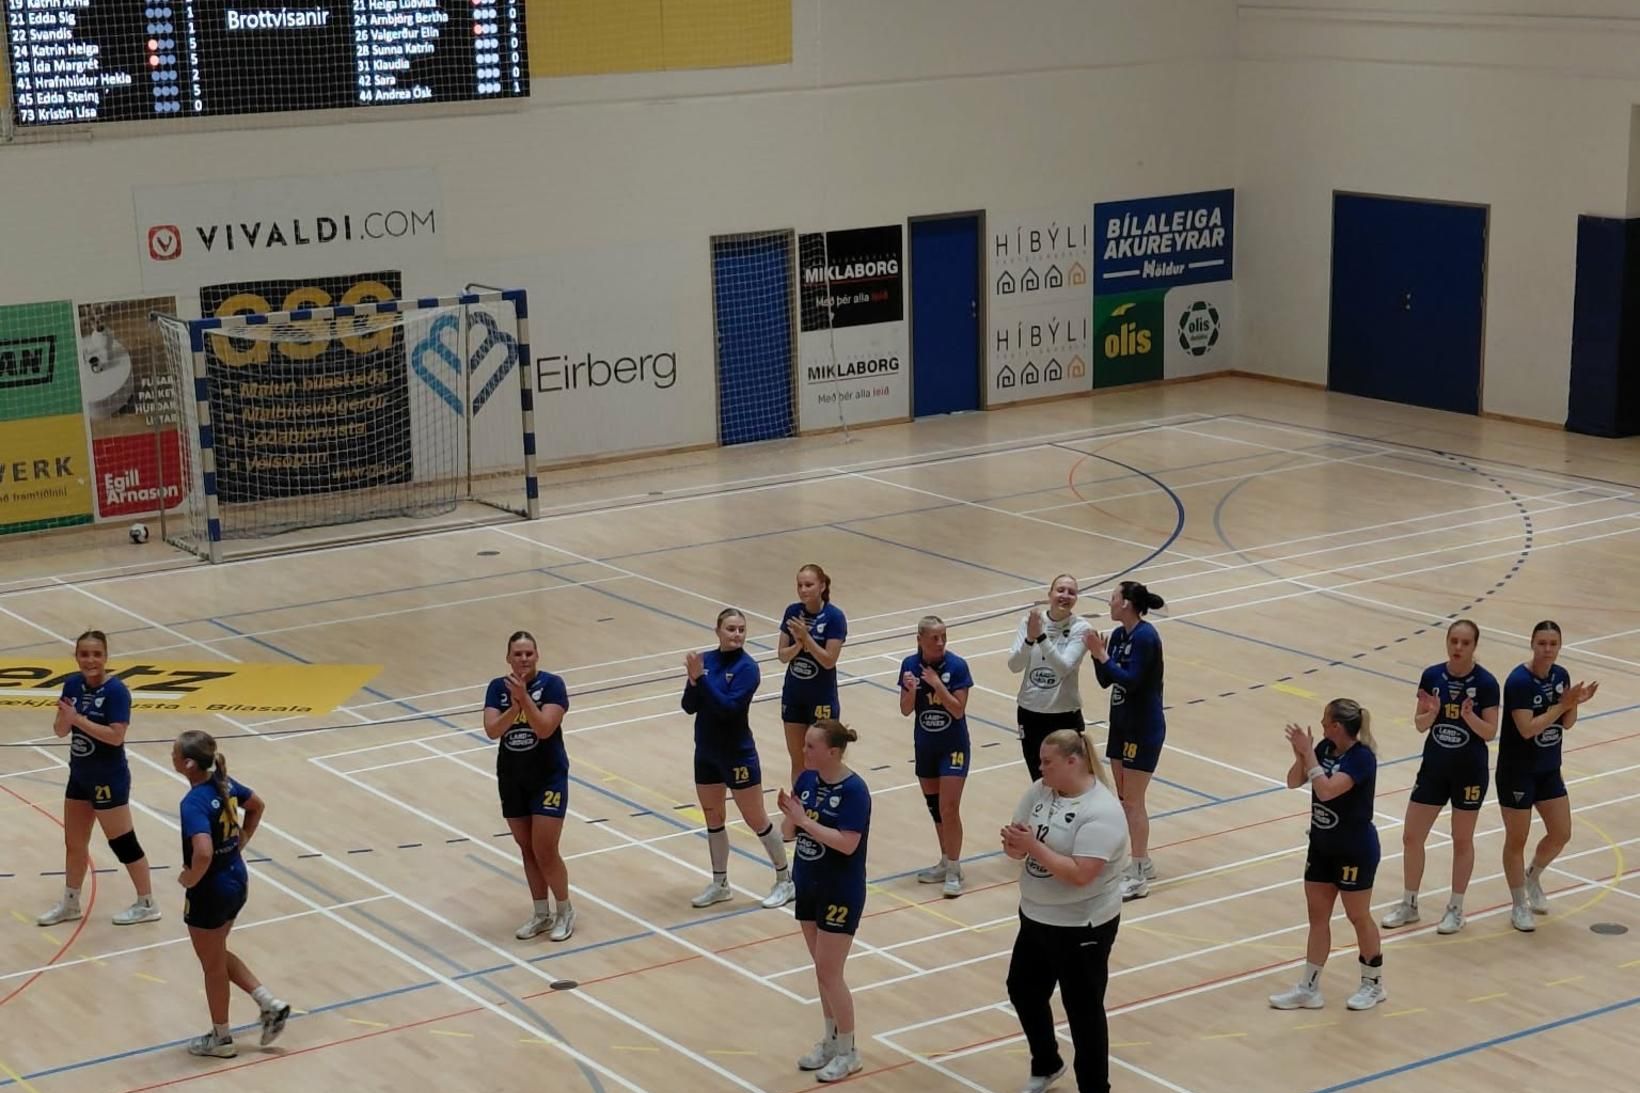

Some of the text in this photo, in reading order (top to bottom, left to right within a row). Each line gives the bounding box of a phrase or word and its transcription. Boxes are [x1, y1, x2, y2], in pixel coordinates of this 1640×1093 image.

[187, 6, 194, 18] 1
[353, 0, 366, 11] 21
[369, 0, 397, 12] Helga
[10, 11, 76, 25] 21 Edda Sig
[227, 6, 329, 29] Brottvísanir
[354, 14, 367, 26] 24
[415, 11, 449, 23] Bertha
[509, 8, 516, 19] 0
[188, 22, 195, 34] 1
[510, 22, 517, 33] 4
[12, 29, 27, 41] 22
[355, 29, 368, 41] 26
[189, 37, 197, 49] 5
[511, 37, 519, 48] 0
[14, 45, 28, 58] 24
[67, 42, 99, 56] Helga
[357, 45, 369, 56] 28
[372, 45, 403, 56] Sunna
[190, 54, 198, 65] 5
[358, 58, 410, 71] 31 Klaudia
[512, 52, 520, 63] 0
[16, 61, 30, 73] 28
[53, 58, 99, 73] Margrét
[513, 66, 520, 77] 0
[17, 72, 132, 89] 41 Hrafnhildur Hekla
[192, 69, 200, 81] 2
[358, 75, 396, 86] 42 Sara
[193, 84, 201, 96] 5
[514, 81, 521, 92] 1
[18, 93, 33, 105] 45
[37, 91, 64, 104] Edda
[359, 90, 372, 101] 44
[375, 88, 411, 100] Andrea
[194, 99, 203, 111] 0
[21, 105, 97, 122] 73 Kristín Lísa
[196, 209, 436, 251] VIVALDI.COM
[1106, 207, 1222, 239] BÍLALEIGA
[996, 222, 1087, 257] HÍBÝLI
[1103, 227, 1225, 261] AKUREYRAR
[805, 259, 899, 283] MIKLABORG
[854, 292, 870, 303] alla
[996, 317, 1087, 352] HÍBÝLI
[536, 352, 677, 392] Eirberg
[807, 357, 899, 381] MIKLABORG
[854, 389, 870, 399] alla
[145, 413, 176, 426] LITAR
[104, 468, 140, 493] Egill
[814, 705, 831, 720] 45
[1444, 704, 1461, 720] 15
[95, 785, 112, 800] 21
[543, 790, 561, 808] 24
[1464, 786, 1481, 801] 15
[1035, 824, 1050, 844] 12
[1341, 865, 1359, 882] 11
[825, 904, 849, 923] 22
